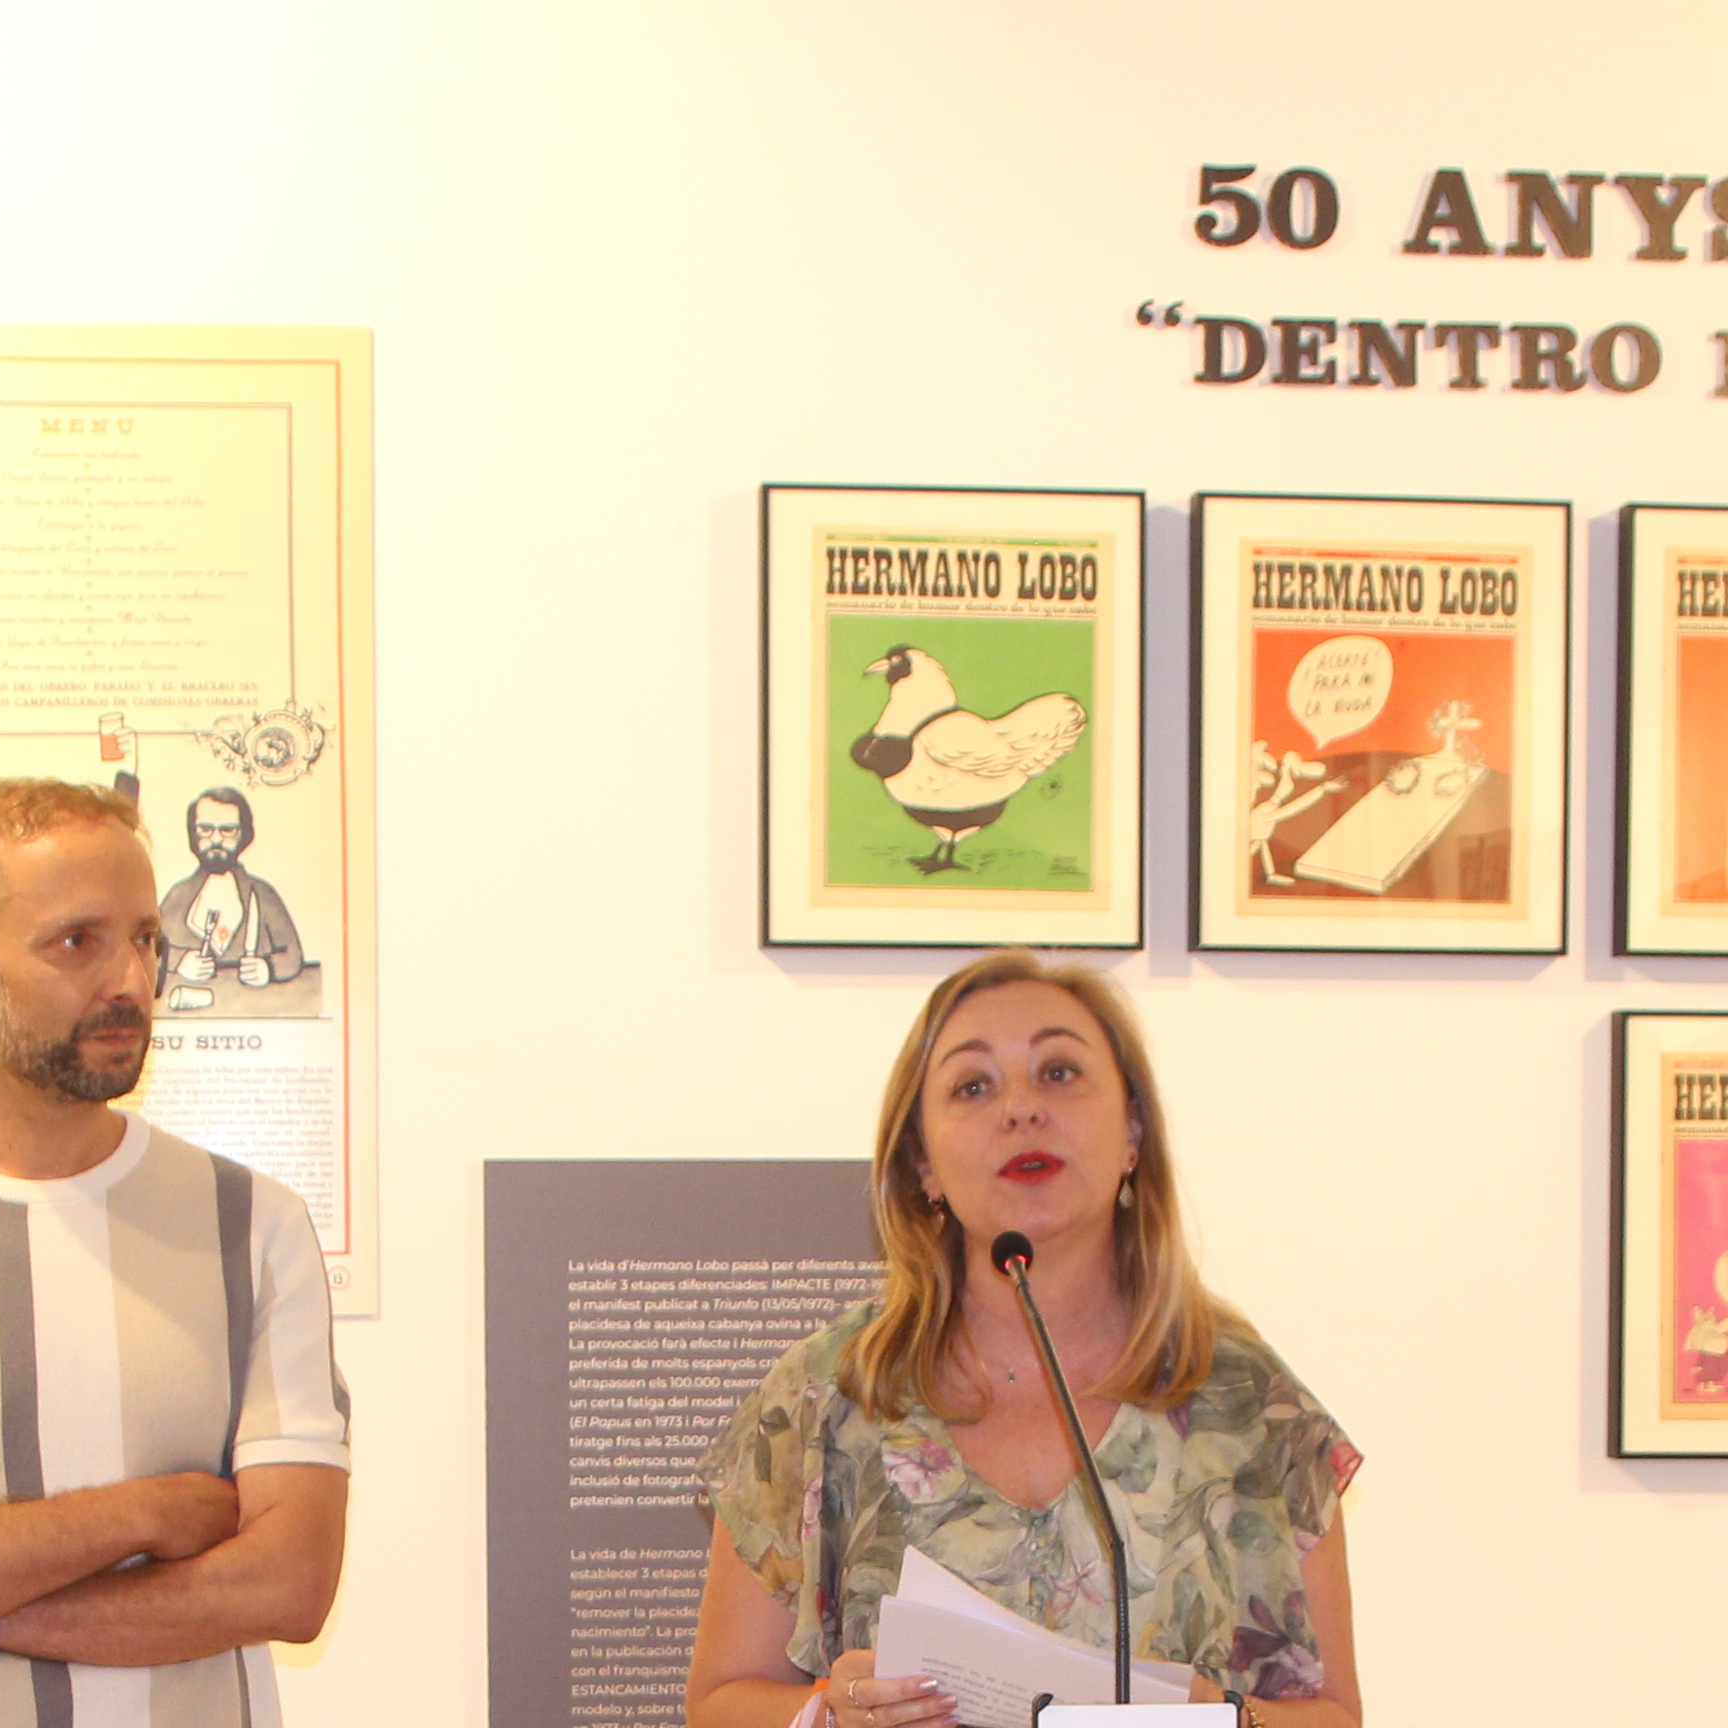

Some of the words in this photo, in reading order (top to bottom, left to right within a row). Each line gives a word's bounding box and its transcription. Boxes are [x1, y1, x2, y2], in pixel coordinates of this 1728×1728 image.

[1194, 165, 1339, 252] 50
[39, 417, 137, 434] MENU
[826, 547, 1002, 598] HERMANO
[1017, 551, 1098, 600] LOBO
[1252, 561, 1424, 612] HERMANO
[1439, 568, 1518, 616] LOBO
[152, 1035, 184, 1050] SU
[195, 1035, 263, 1050] SITIO
[569, 1260, 584, 1272] La
[588, 1260, 615, 1272] vida
[697, 1260, 729, 1272] Lobo
[732, 1260, 769, 1274] passà
[772, 1262, 794, 1274] per
[797, 1260, 855, 1272] diferents
[569, 1278, 617, 1290] establir
[621, 1278, 628, 1290] 3
[632, 1278, 676, 1294] etapes
[772, 1278, 831, 1290] IMPACTE
[569, 1298, 581, 1310] el
[584, 1298, 641, 1310] manifest
[645, 1298, 698, 1313] publicat
[702, 1301, 710, 1310] a
[714, 1298, 759, 1310] Triunfo
[570, 1318, 631, 1332] placidesa
[634, 1318, 651, 1330] de
[655, 1318, 705, 1332] aqueixa
[708, 1318, 763, 1332] cabanya
[766, 1318, 801, 1330] ovina
[805, 1320, 813, 1330] a
[815, 1318, 828, 1330] la
[570, 1337, 585, 1349] La
[589, 1337, 659, 1352] provocació
[663, 1337, 687, 1349] farà
[690, 1337, 731, 1349] efecte
[734, 1337, 738, 1349] i
[570, 1356, 628, 1372] preferida
[632, 1356, 649, 1368] de
[652, 1356, 689, 1368] molts
[692, 1356, 757, 1372] espanyols
[570, 1376, 646, 1391] ultrapassen
[649, 1376, 667, 1388] els
[671, 1376, 721, 1388] 100.000
[571, 1548, 586, 1560] La
[590, 1548, 617, 1560] vida
[620, 1548, 637, 1560] de
[640, 1548, 703, 1560] Hermano
